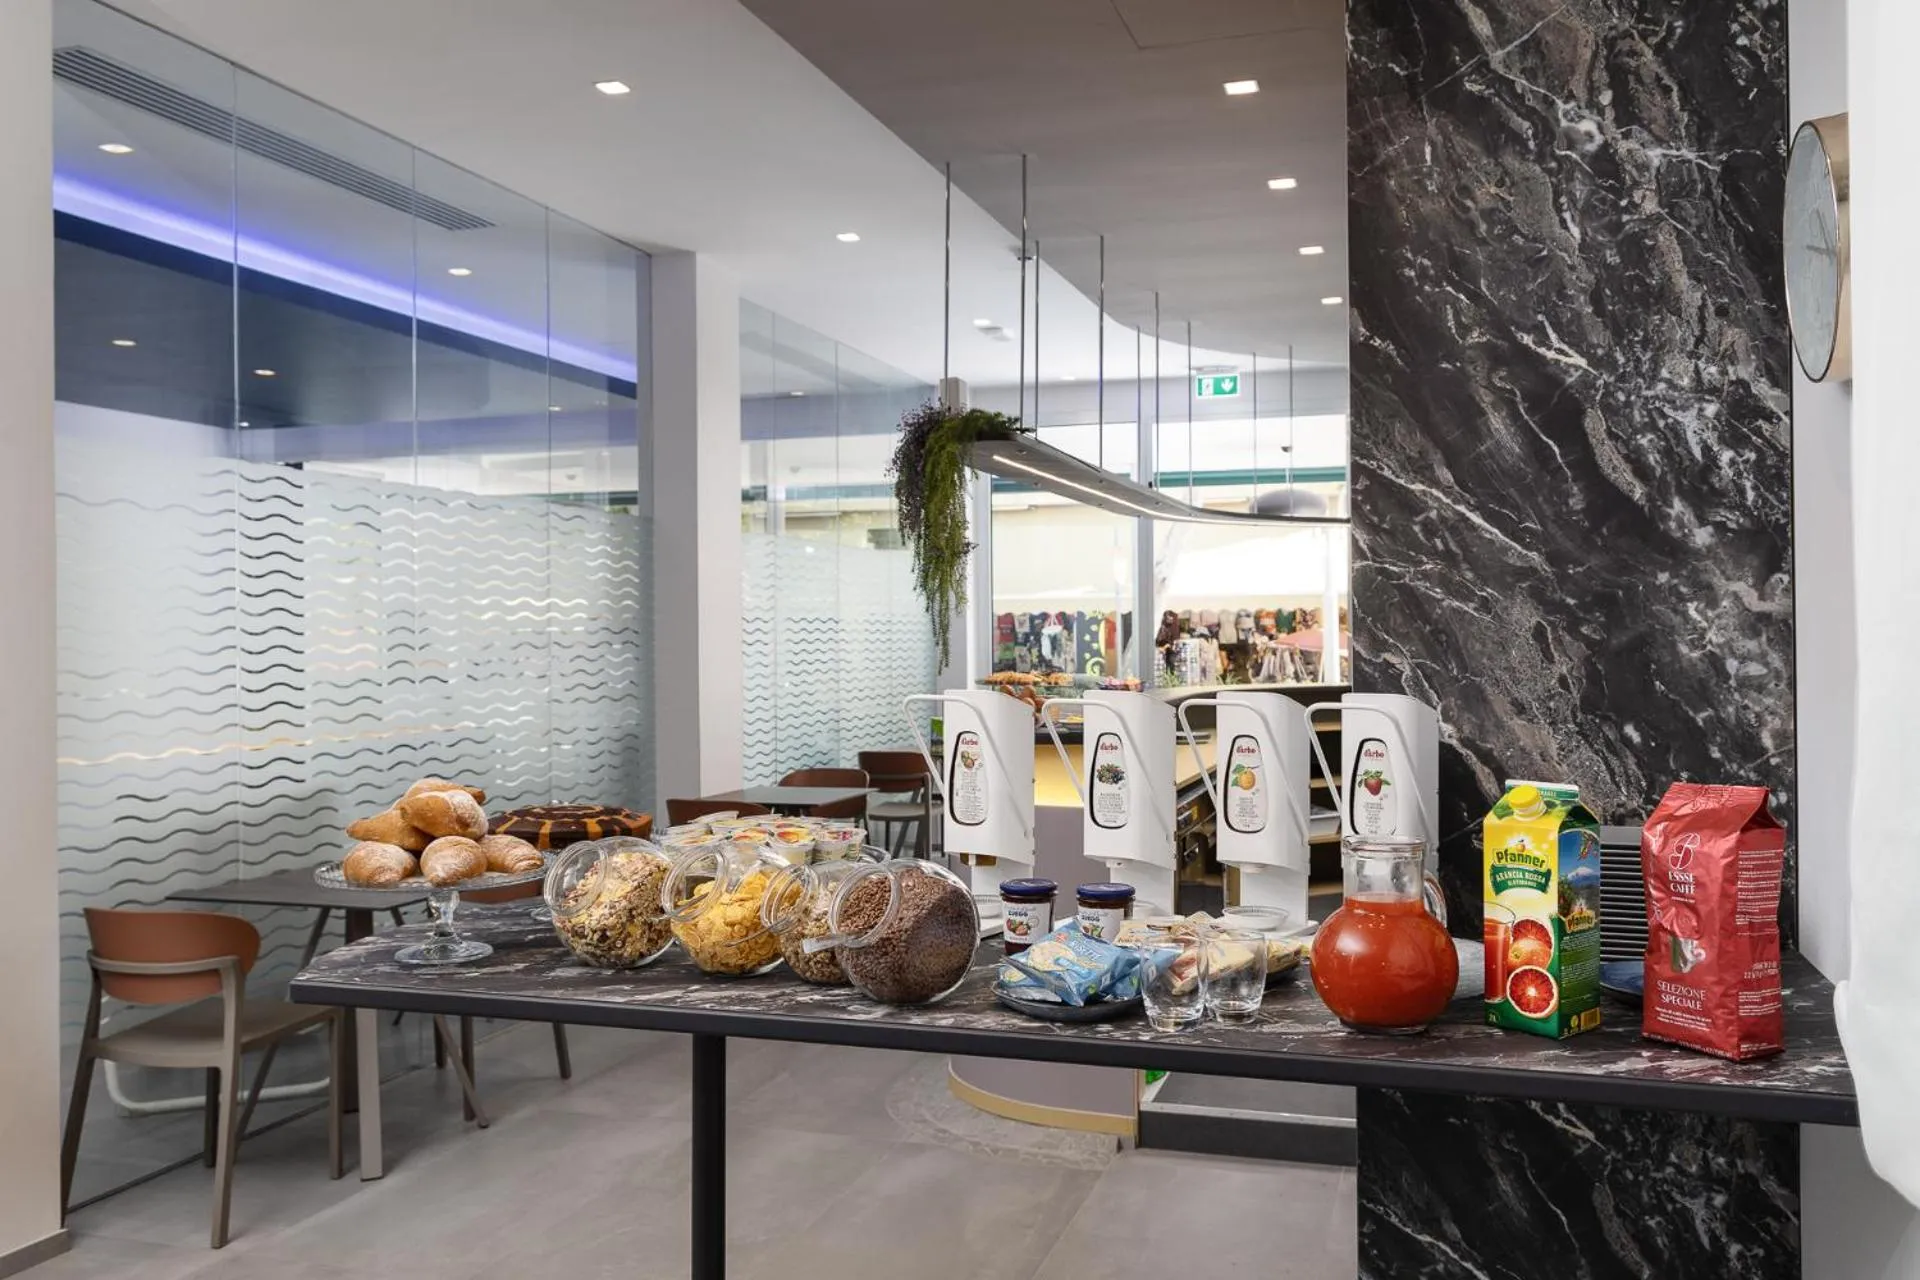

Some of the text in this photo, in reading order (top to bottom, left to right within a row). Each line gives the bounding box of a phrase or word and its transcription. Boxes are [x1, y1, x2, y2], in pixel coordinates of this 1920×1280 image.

[1496, 870, 1523, 883] ARANCIA
[1656, 979, 1706, 1001] SELEZIONE
[1661, 993, 1703, 1011] SPECIALE
